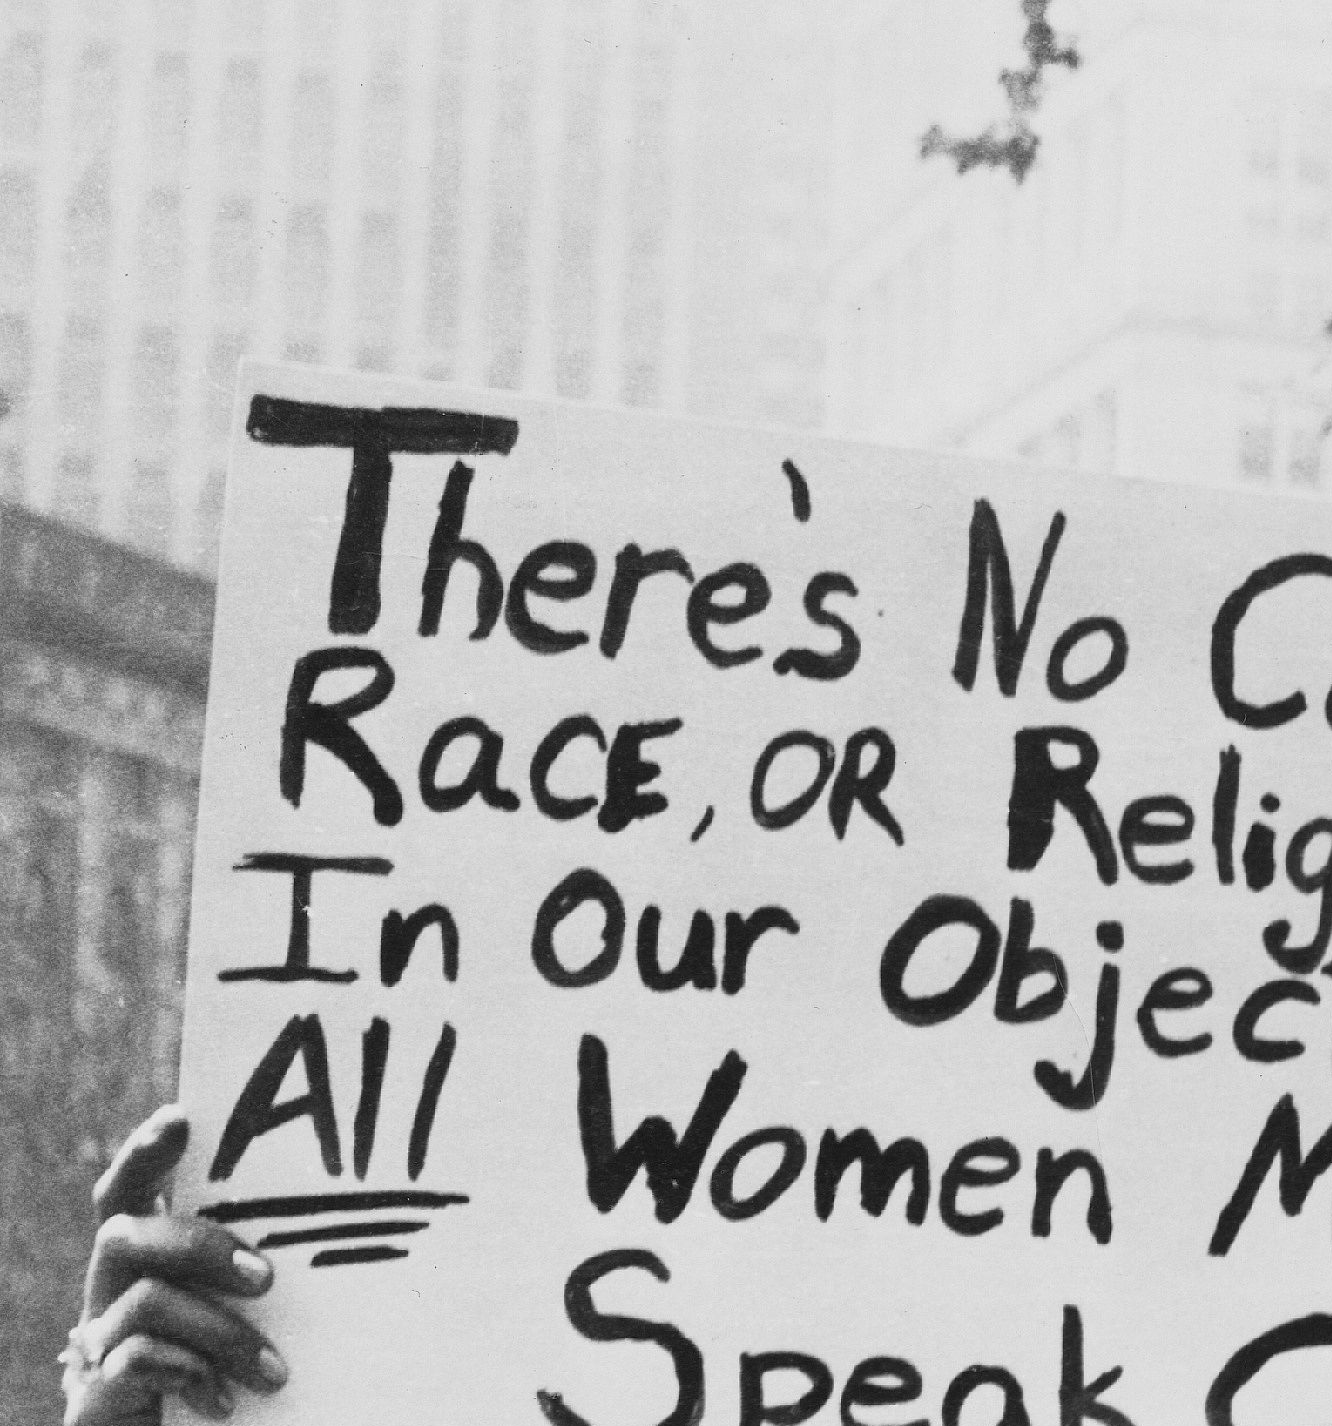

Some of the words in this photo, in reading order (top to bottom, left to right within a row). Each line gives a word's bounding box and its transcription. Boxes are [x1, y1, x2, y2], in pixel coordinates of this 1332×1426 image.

[247, 395, 862, 681] There's
[951, 499, 1130, 702] No
[750, 726, 905, 846] OR
[217, 852, 460, 988] In
[531, 868, 800, 995] Our
[207, 1013, 457, 1182] All
[577, 1034, 1113, 1245] Women
